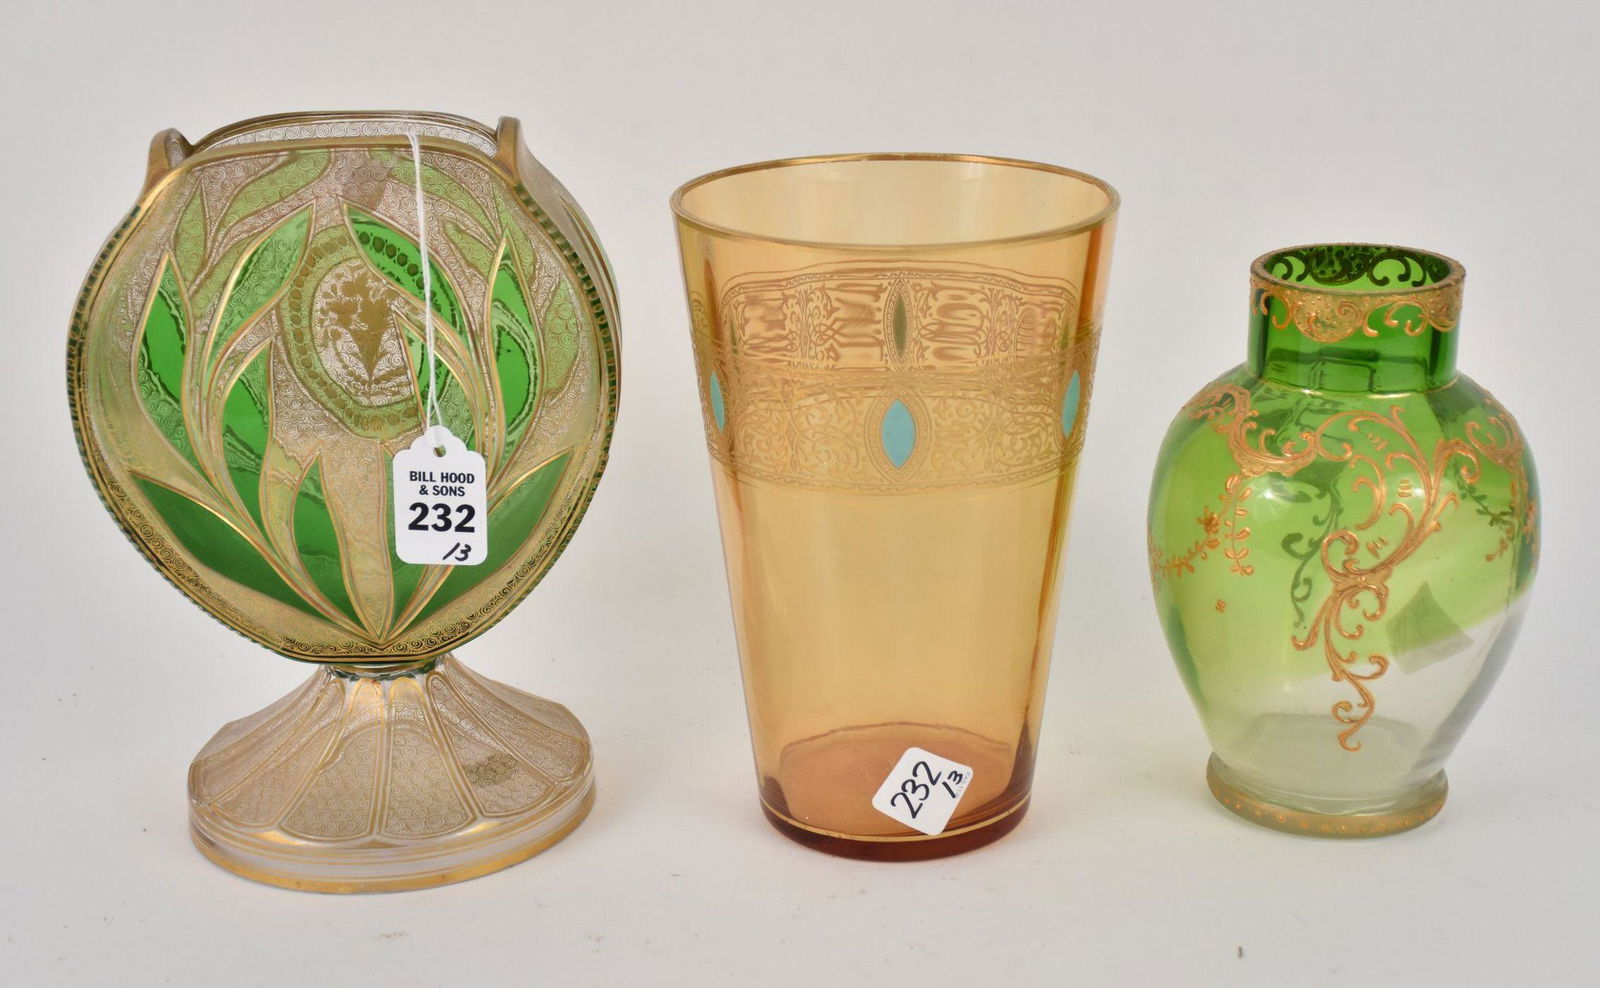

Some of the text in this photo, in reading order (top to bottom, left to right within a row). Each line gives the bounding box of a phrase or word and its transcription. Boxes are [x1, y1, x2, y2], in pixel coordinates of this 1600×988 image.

[409, 471, 475, 484] BILL HOOD
[419, 485, 466, 497] & SONS
[408, 502, 475, 533] 232
[890, 760, 942, 819] 232
